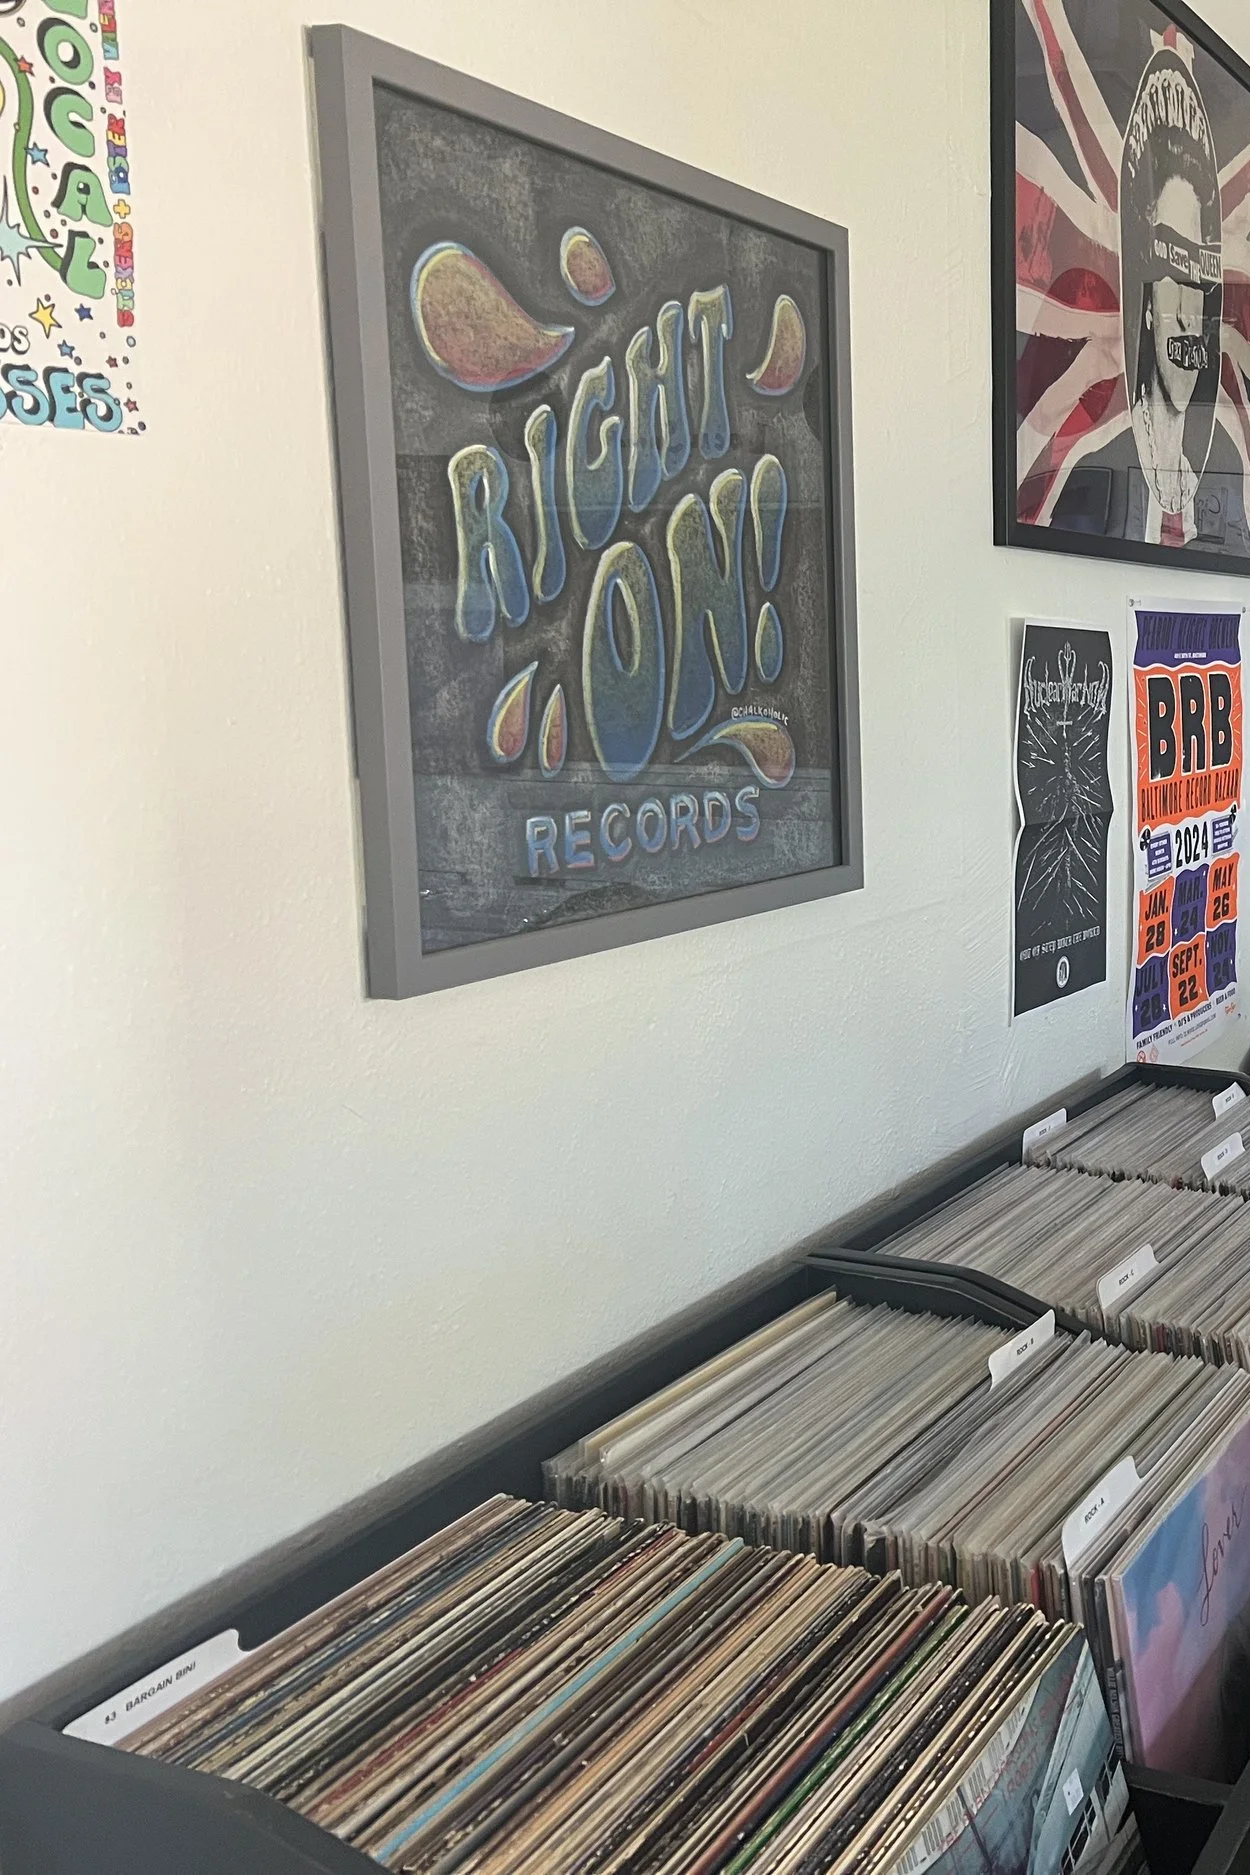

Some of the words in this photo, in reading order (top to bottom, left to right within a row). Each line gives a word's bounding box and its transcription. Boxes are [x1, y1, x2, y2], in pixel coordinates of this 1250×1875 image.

[0, 363, 123, 432] SES
[447, 284, 734, 643] RIGHT
[582, 453, 787, 782] ON!
[1147, 673, 1233, 780] BRB
[1141, 780, 1183, 823] BALTIMORE
[1186, 774, 1212, 811] RECORD
[1214, 768, 1239, 803] BAZAAR
[525, 787, 762, 879] RECORDS
[1175, 821, 1209, 868] 2024
[1177, 875, 1203, 905] MAR.
[1212, 859, 1235, 893] MAY
[1144, 895, 1169, 921] JAN.
[1180, 907, 1199, 936] 24
[1213, 892, 1230, 922] 26
[1144, 919, 1166, 953] 28
[1209, 933, 1232, 958] NOV.
[1136, 960, 1167, 997] JULY
[1172, 943, 1202, 979] SEPT.
[1178, 975, 1199, 1007] 22
[1136, 1034, 1153, 1049] FAMILY
[1152, 1024, 1173, 1041] FRIENDLY
[1199, 1485, 1247, 1627] Lover
[104, 1710, 117, 1725] $3
[125, 1675, 173, 1712] BARGAIN
[175, 1661, 197, 1681] BIN!
